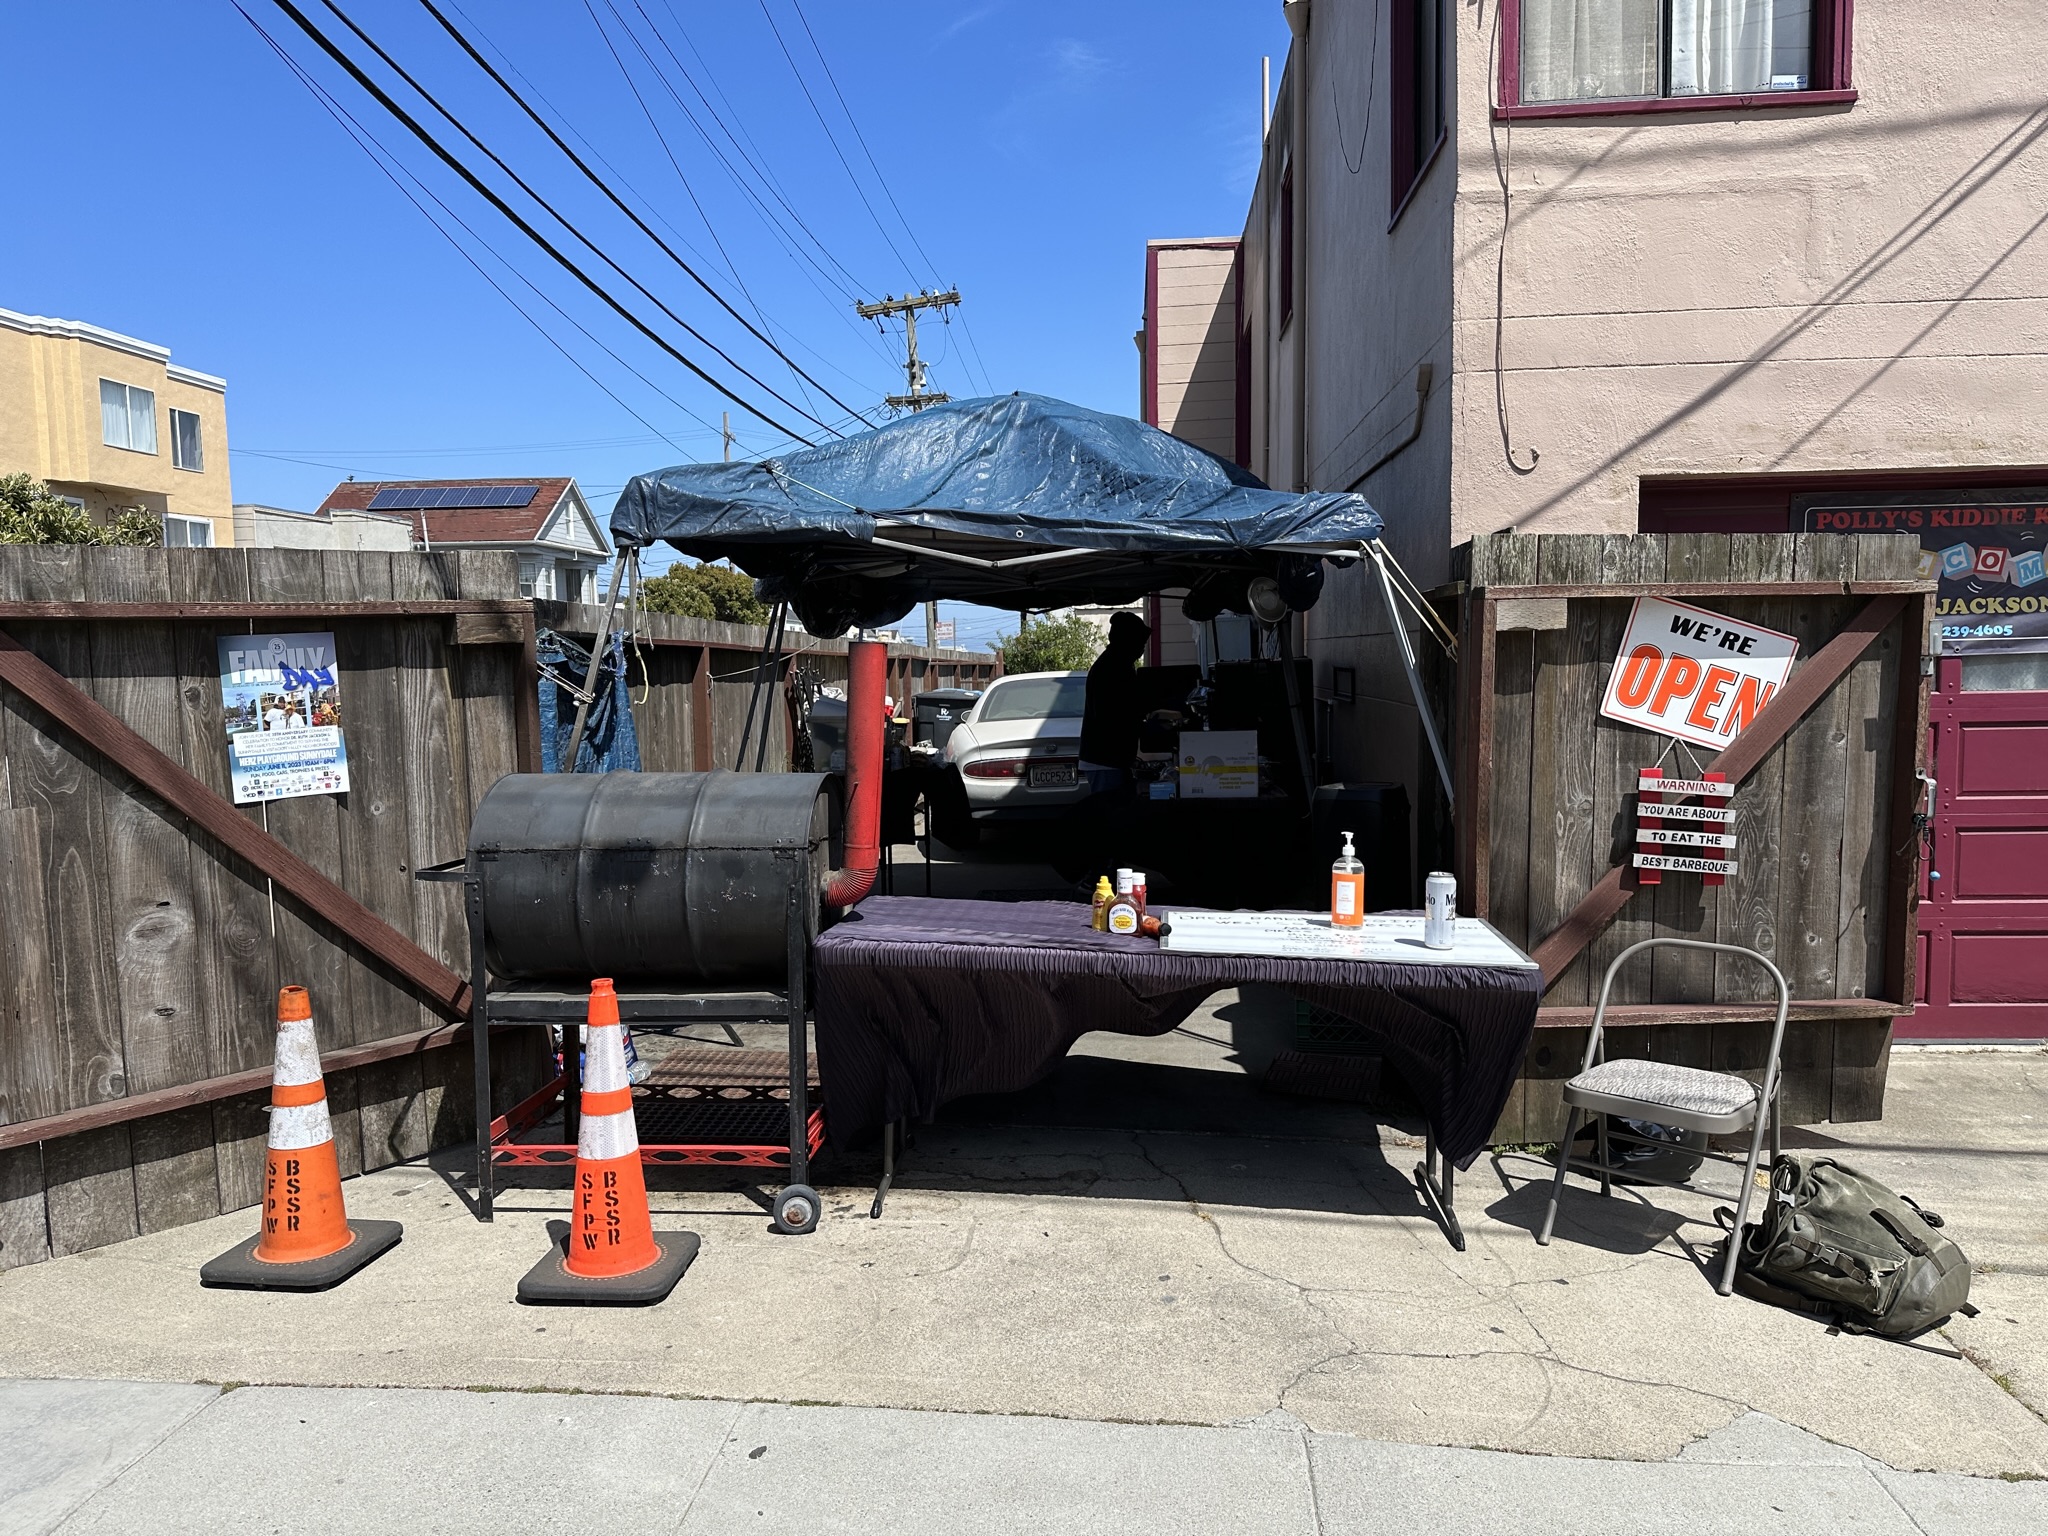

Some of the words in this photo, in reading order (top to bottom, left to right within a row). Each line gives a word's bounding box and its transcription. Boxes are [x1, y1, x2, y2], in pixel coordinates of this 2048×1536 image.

[1816, 510, 1923, 529] POLLY'S
[1930, 508, 2027, 526] KIDDIE
[1669, 614, 1757, 656] WE'RE
[1942, 624, 2013, 637] 239-4605
[278, 661, 335, 692] DAY
[1615, 643, 1777, 737] OPEN
[1035, 770, 1072, 783] 4CCP523
[1656, 780, 1717, 794] WARNING
[1644, 805, 1665, 815] YOU
[1667, 807, 1689, 818] ARE
[1691, 809, 1729, 821] ABOUT
[1651, 831, 1667, 842] TO
[1671, 832, 1693, 844] EAT
[1699, 834, 1722, 845] THE
[1641, 856, 1669, 868] BEST
[1673, 858, 1729, 873] BARBEQUE
